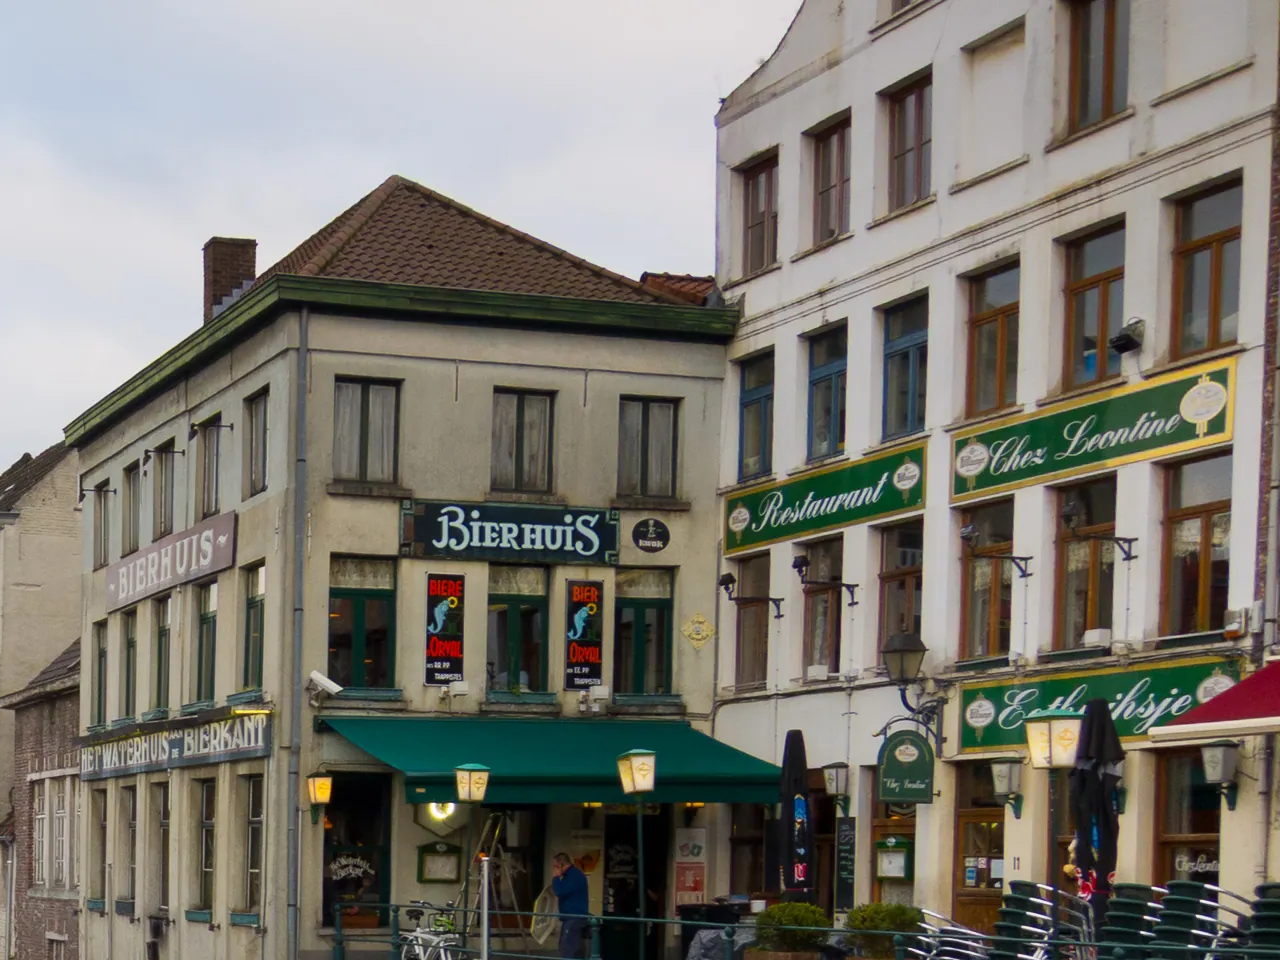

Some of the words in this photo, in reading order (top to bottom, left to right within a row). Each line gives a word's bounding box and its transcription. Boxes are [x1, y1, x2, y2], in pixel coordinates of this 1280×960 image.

[989, 435, 1047, 476] Chez
[1054, 414, 1181, 460] Leontine
[751, 472, 890, 532] Restaurant
[118, 528, 214, 600] BIERHUIS
[572, 586, 599, 603] BIER
[81, 745, 102, 773] HET
[102, 731, 169, 769] WATERHUIS
[183, 714, 267, 757] BIERKANT
